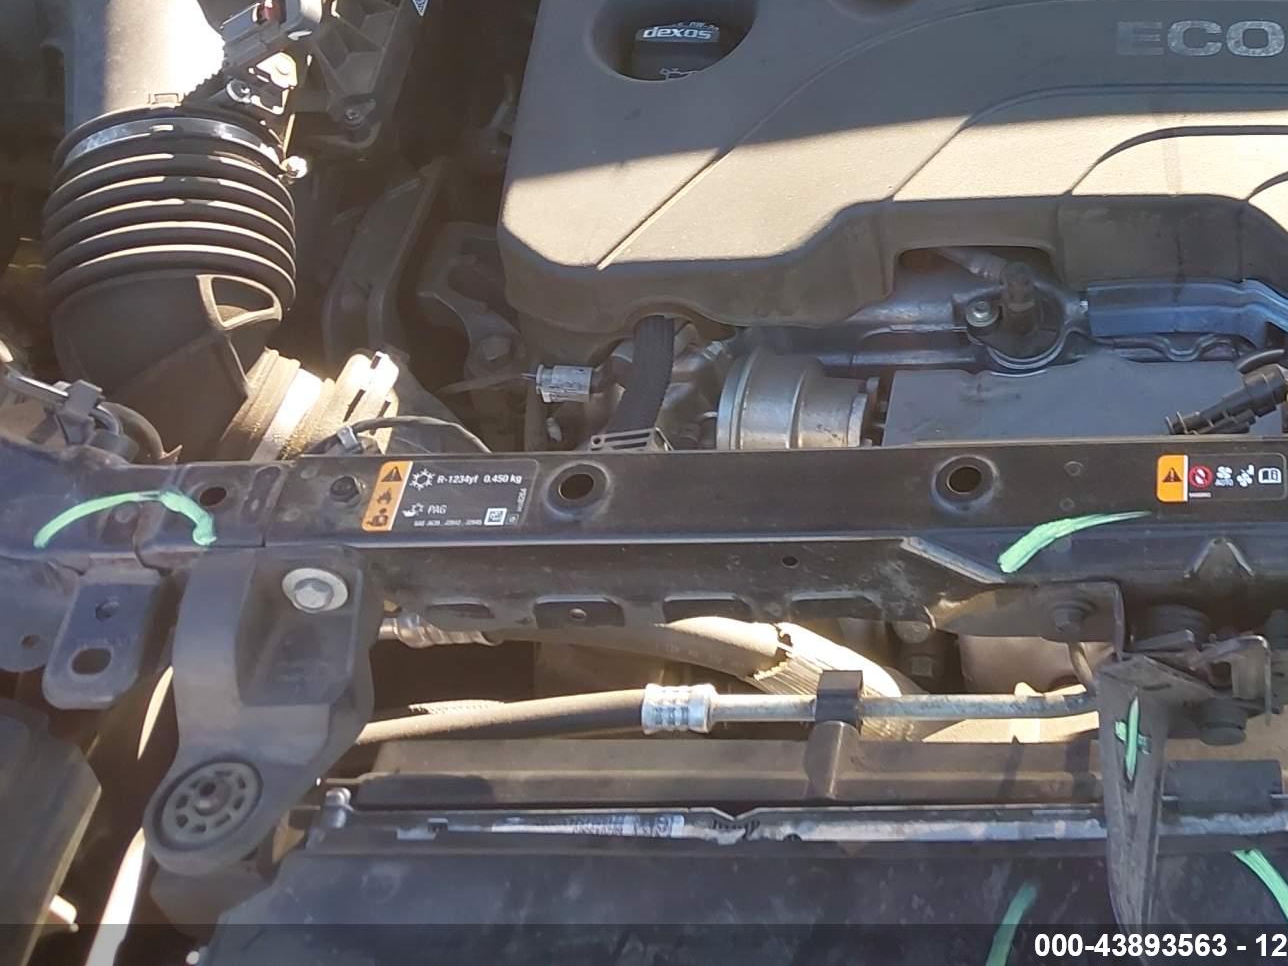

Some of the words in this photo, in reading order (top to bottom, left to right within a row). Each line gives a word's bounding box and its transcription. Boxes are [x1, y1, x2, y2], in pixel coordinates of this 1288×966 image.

[642, 26, 712, 39] dexos
[436, 474, 479, 485] R-1234yf
[483, 474, 509, 484] 0.450
[510, 474, 522, 485] kg
[427, 505, 448, 515] PAG
